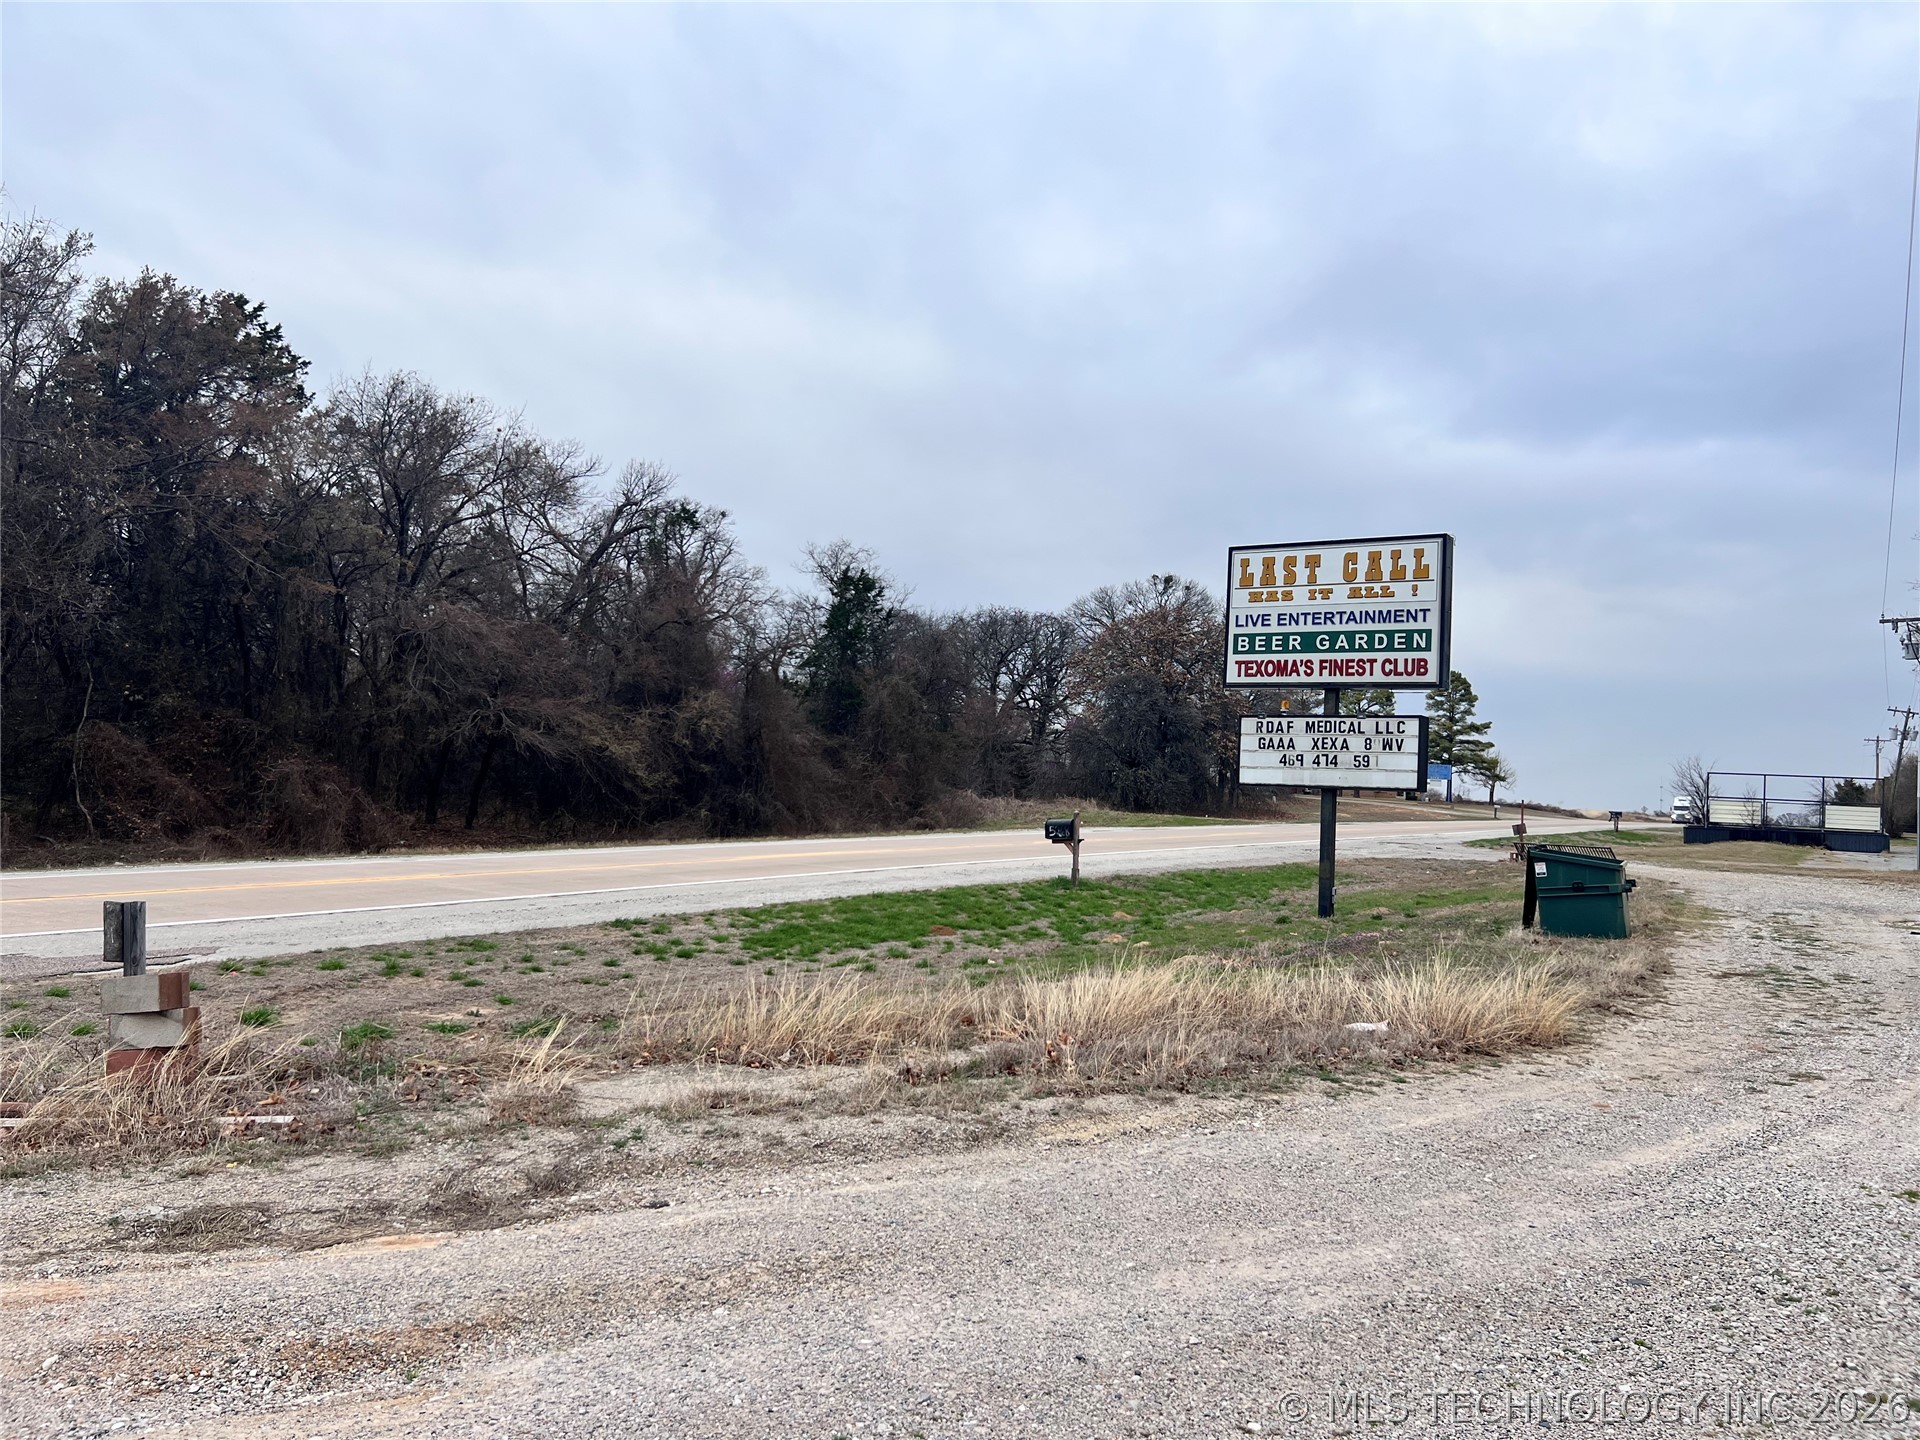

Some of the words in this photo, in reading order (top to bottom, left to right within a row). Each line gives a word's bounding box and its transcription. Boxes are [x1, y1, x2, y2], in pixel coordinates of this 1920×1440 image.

[1239, 553, 1321, 587] LAST
[1342, 547, 1430, 582] CALL
[1248, 589, 1294, 603] HAS
[1308, 588, 1334, 600] IT
[1347, 585, 1395, 599] ALL
[1235, 613, 1272, 628] LIVE
[1277, 608, 1431, 627] ENTERTAINMENT
[1237, 635, 1302, 651] BEER
[1315, 632, 1427, 650] GARDEN
[1235, 658, 1315, 678] TEXOMA'S
[1319, 658, 1378, 677] FINEST
[1381, 657, 1429, 677] CLUB
[1255, 720, 1294, 734] RDAF
[1305, 720, 1366, 734] MEDICAL
[1375, 720, 1406, 734] LLC
[1258, 737, 1296, 750] GAAA
[1311, 737, 1350, 751] XEXA
